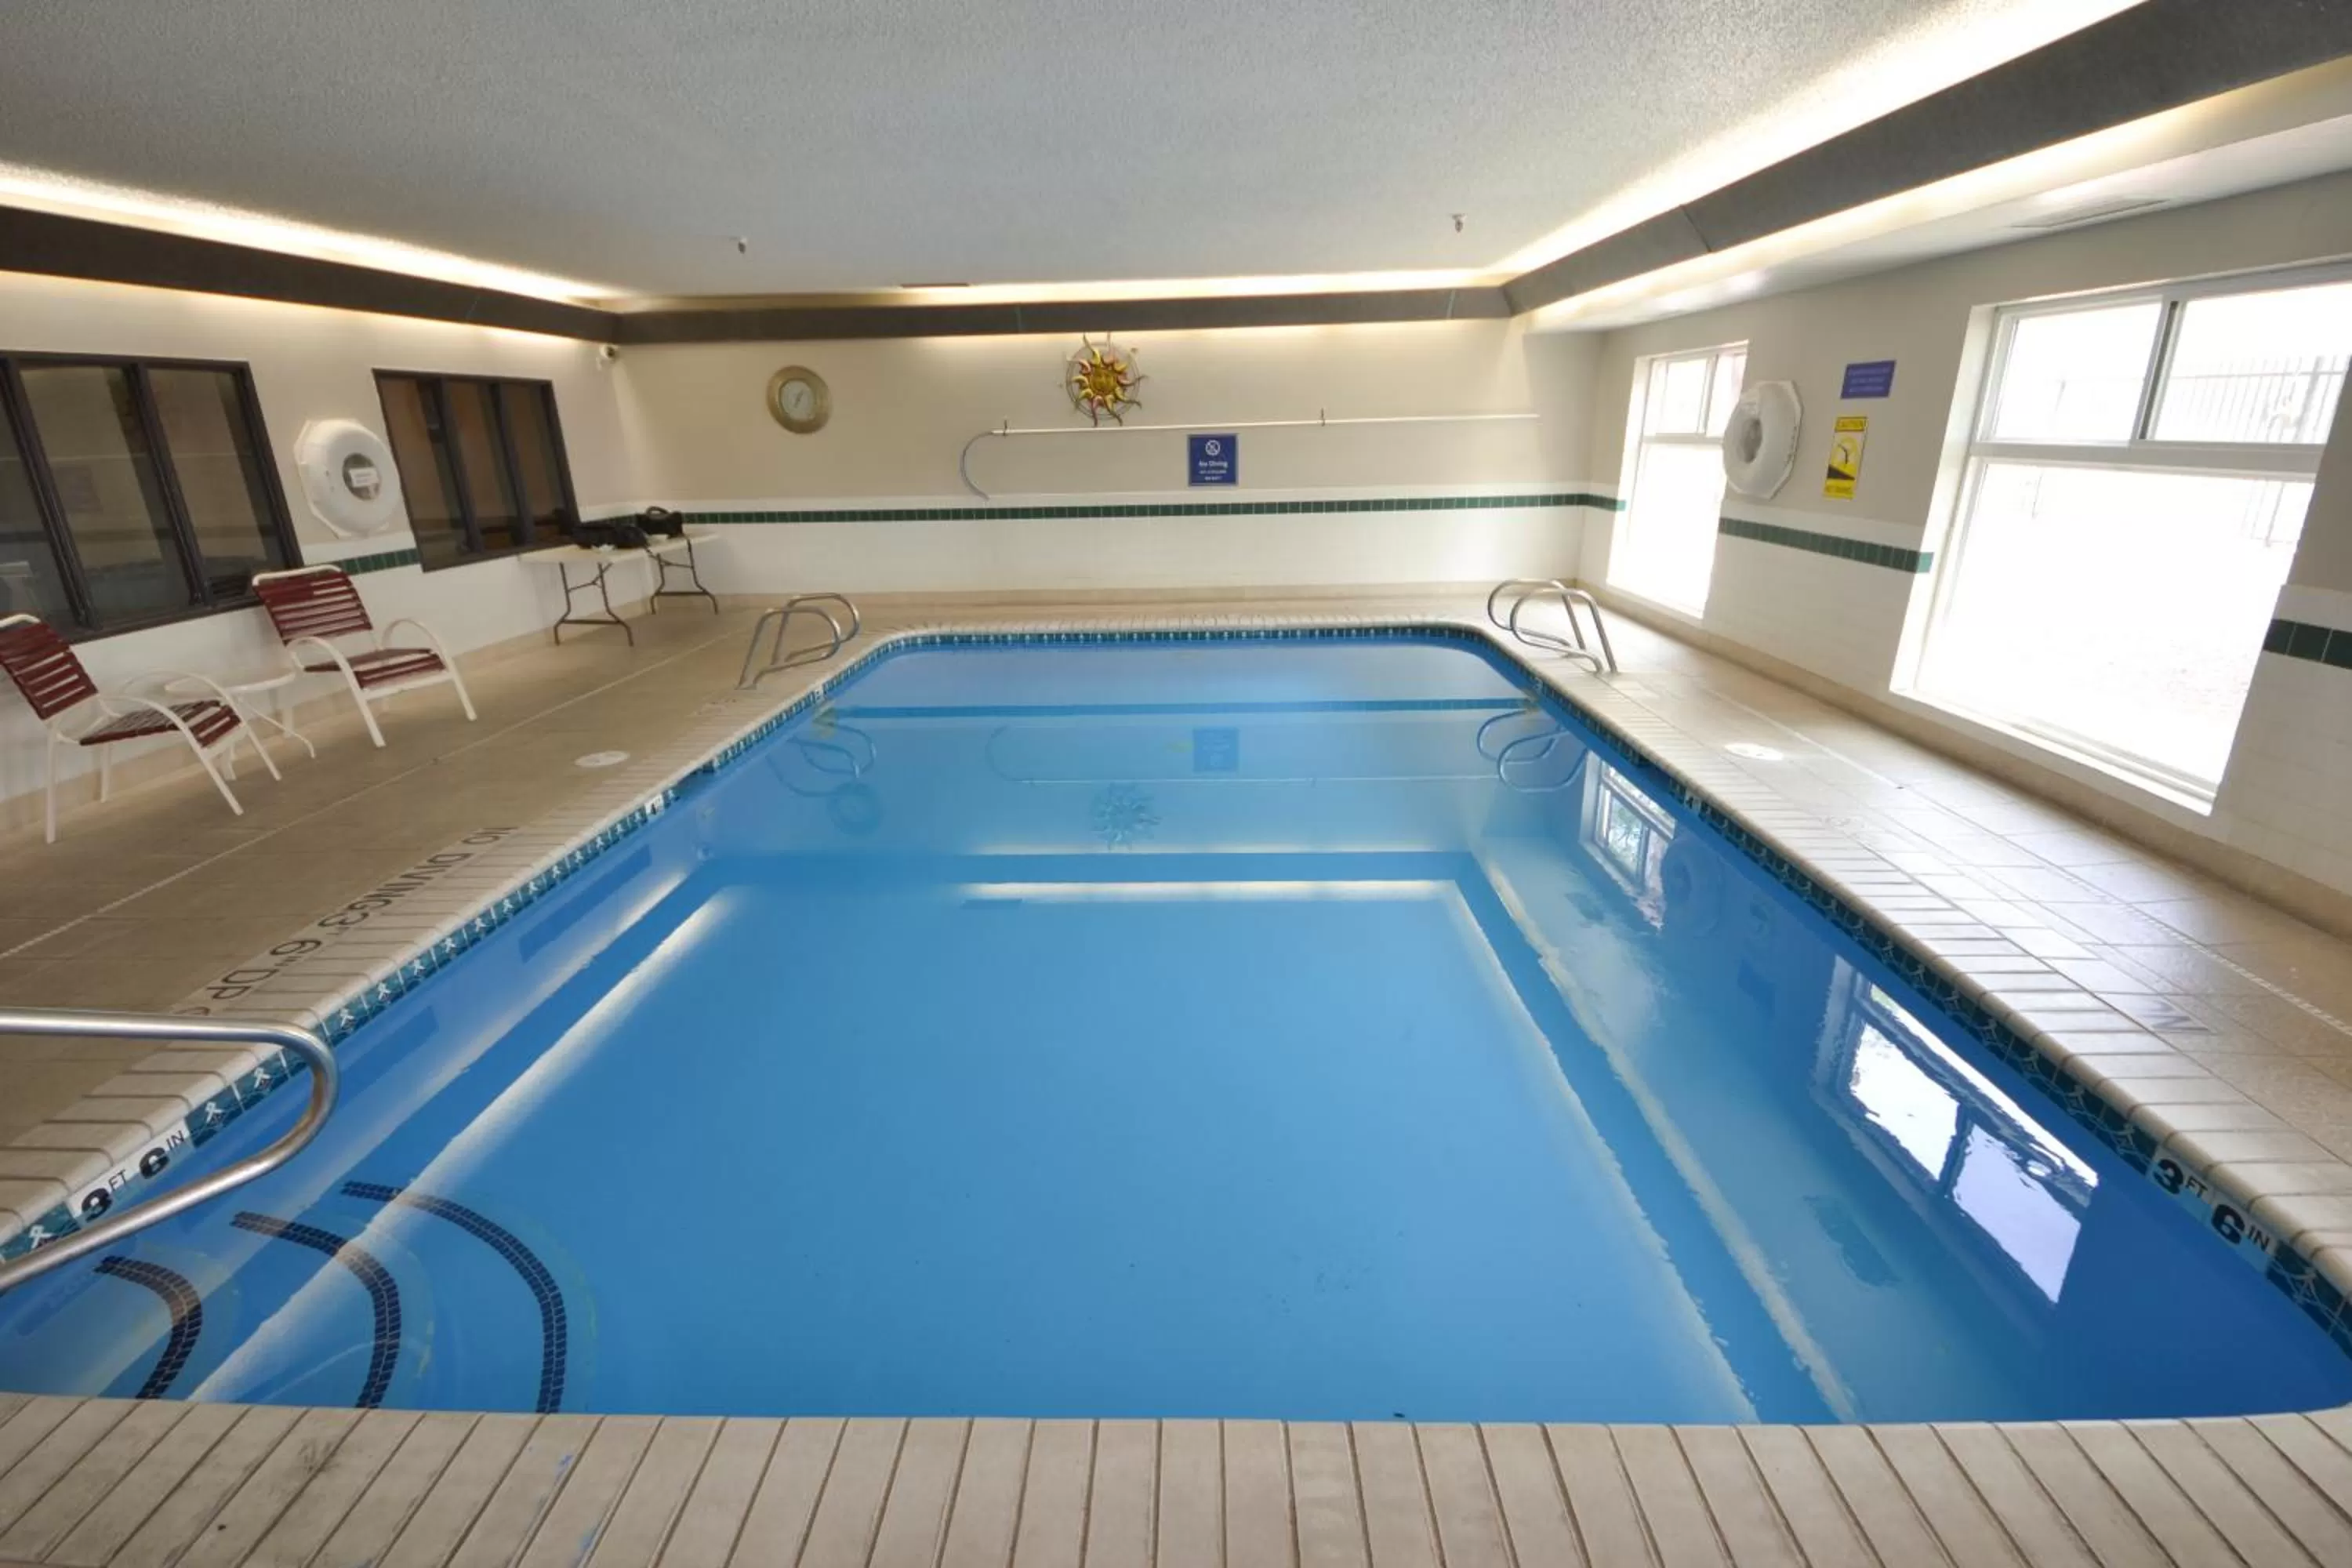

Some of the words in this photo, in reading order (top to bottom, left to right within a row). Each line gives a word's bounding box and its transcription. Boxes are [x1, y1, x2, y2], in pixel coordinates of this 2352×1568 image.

[459, 826, 519, 844] NO
[347, 852, 474, 910] DIVING
[140, 1147, 170, 1179] 6
[165, 1130, 184, 1151] IN
[2212, 1204, 2245, 1244] 6
[2248, 1225, 2270, 1252] IN
